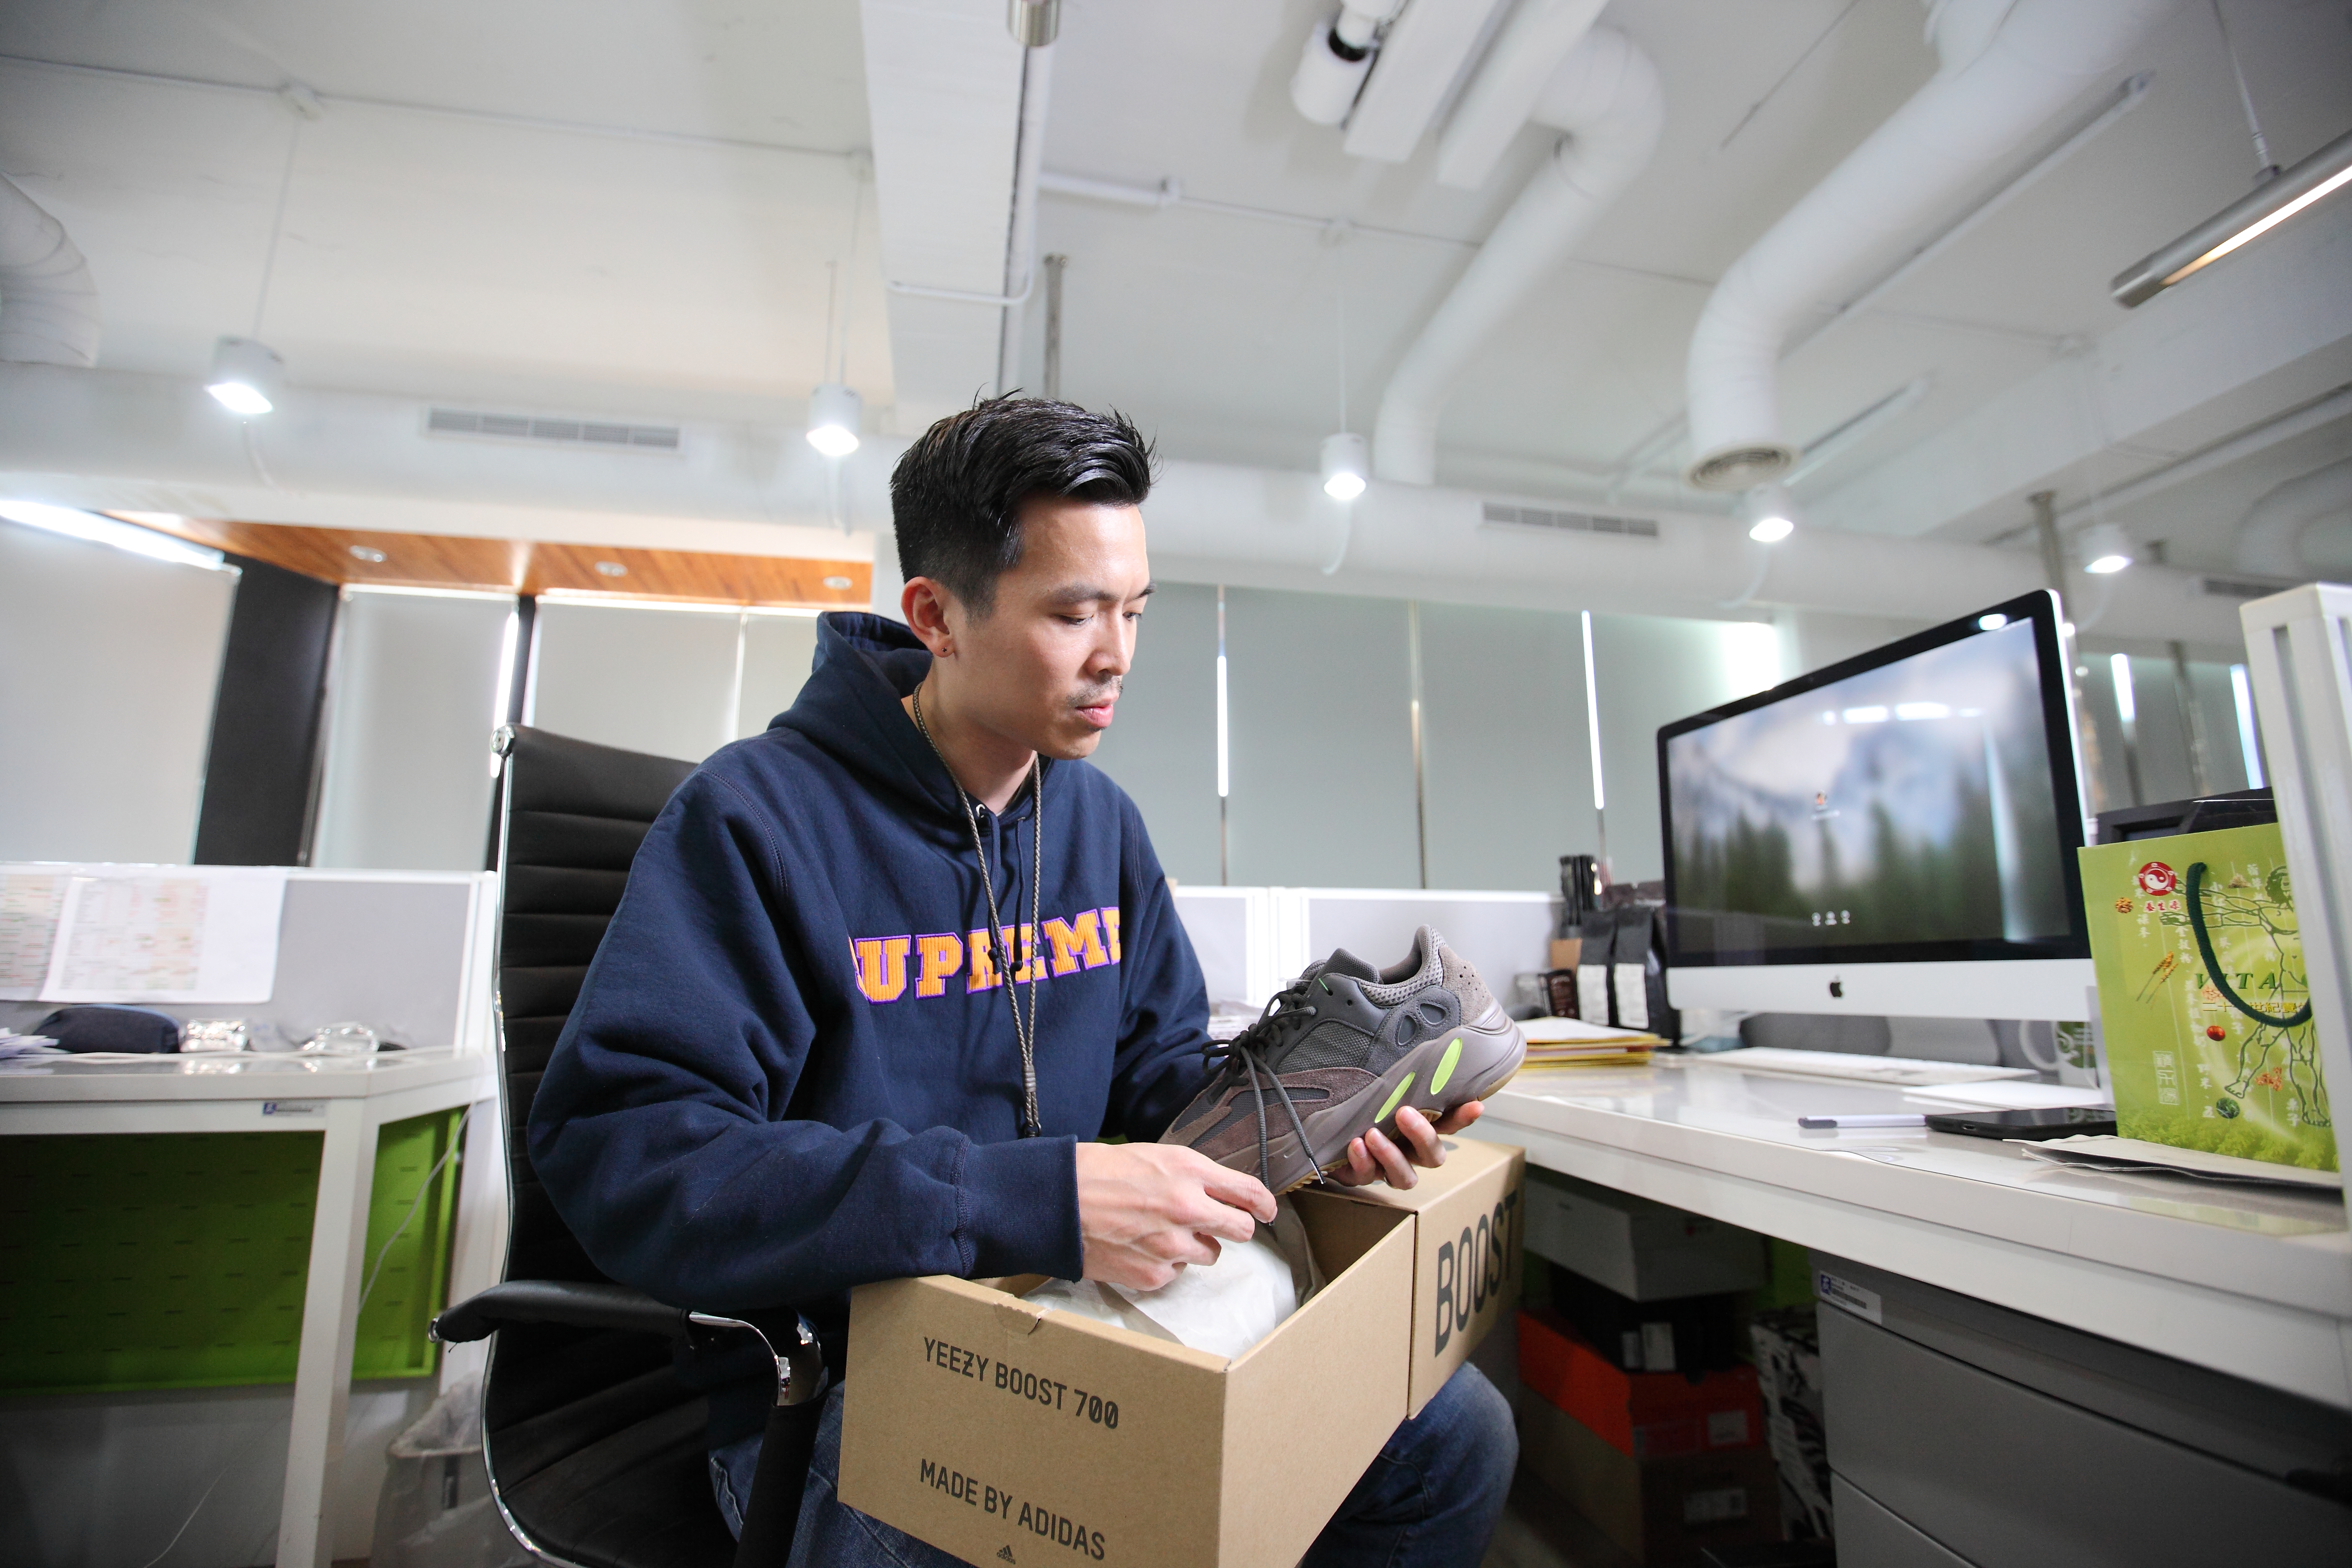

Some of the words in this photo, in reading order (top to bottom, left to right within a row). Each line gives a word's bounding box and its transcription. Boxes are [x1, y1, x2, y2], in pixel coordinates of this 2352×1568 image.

[848, 906, 1121, 1003] UPREM
[2195, 971, 2277, 989] VTA
[1435, 1189, 1519, 1357] BOOST
[923, 1337, 989, 1382] YEEZY
[995, 1362, 1067, 1410] BOOST
[1074, 1389, 1119, 1429] 700
[920, 1458, 978, 1506] MADE
[984, 1485, 1013, 1519] BY
[1018, 1501, 1106, 1561] ADIDAS
[996, 1552, 1016, 1565] adidas
